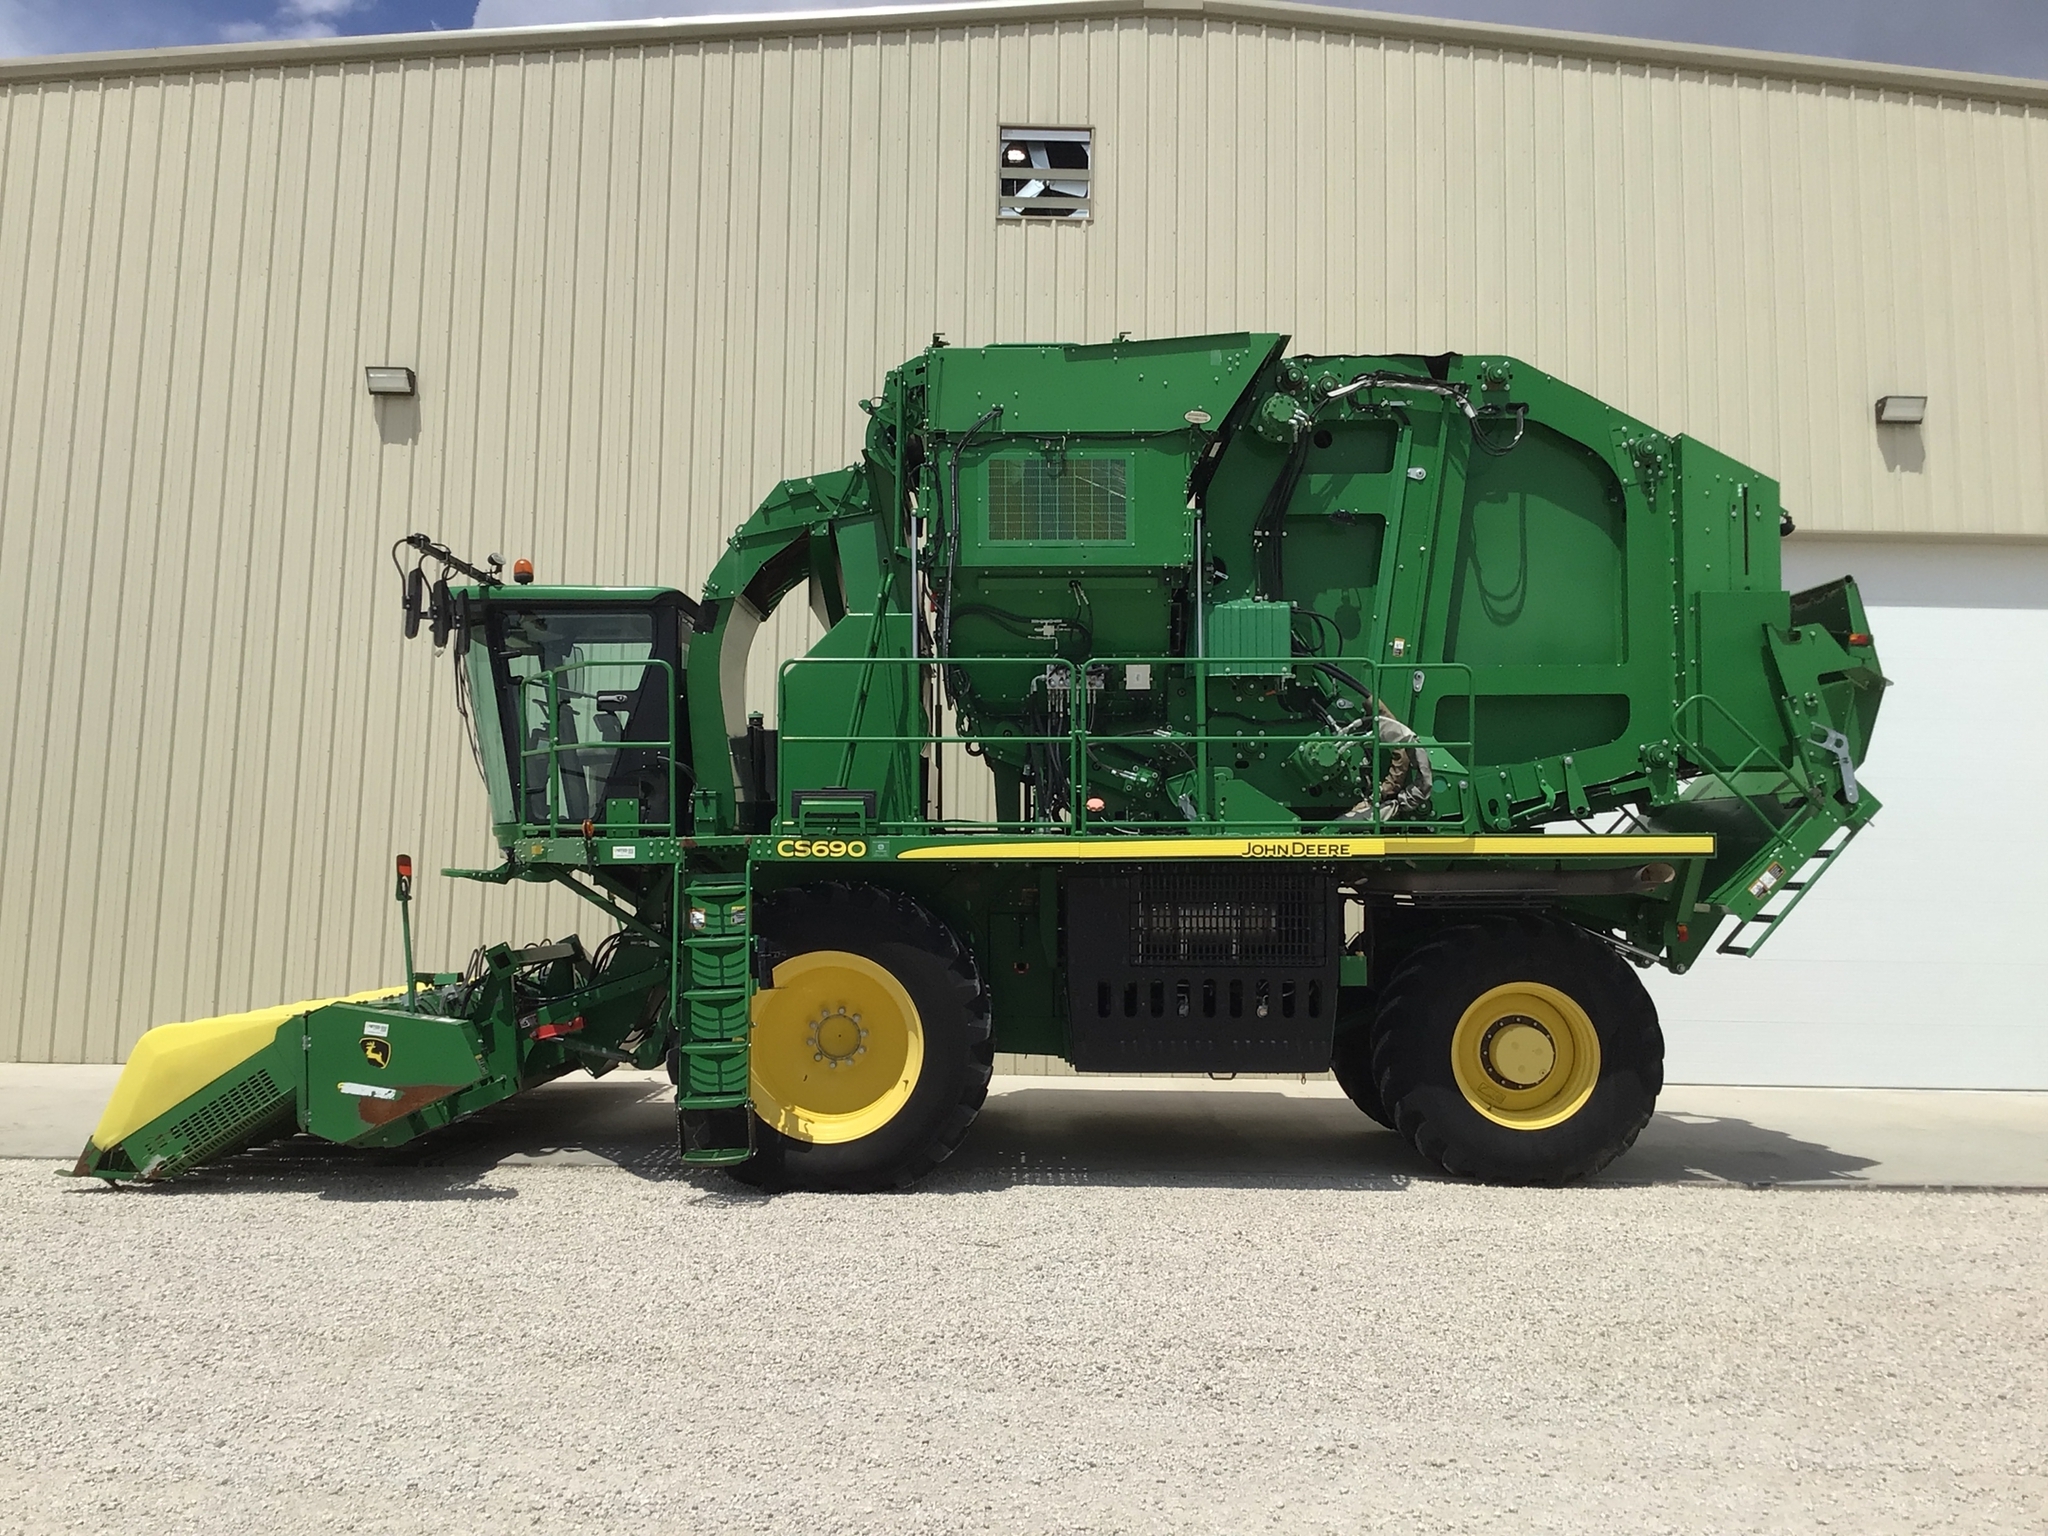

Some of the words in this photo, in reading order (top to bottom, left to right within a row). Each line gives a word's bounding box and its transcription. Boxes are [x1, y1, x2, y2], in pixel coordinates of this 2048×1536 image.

[777, 840, 867, 857] CS690
[1241, 842, 1289, 856] JOHN
[1292, 842, 1351, 855] DEERE
